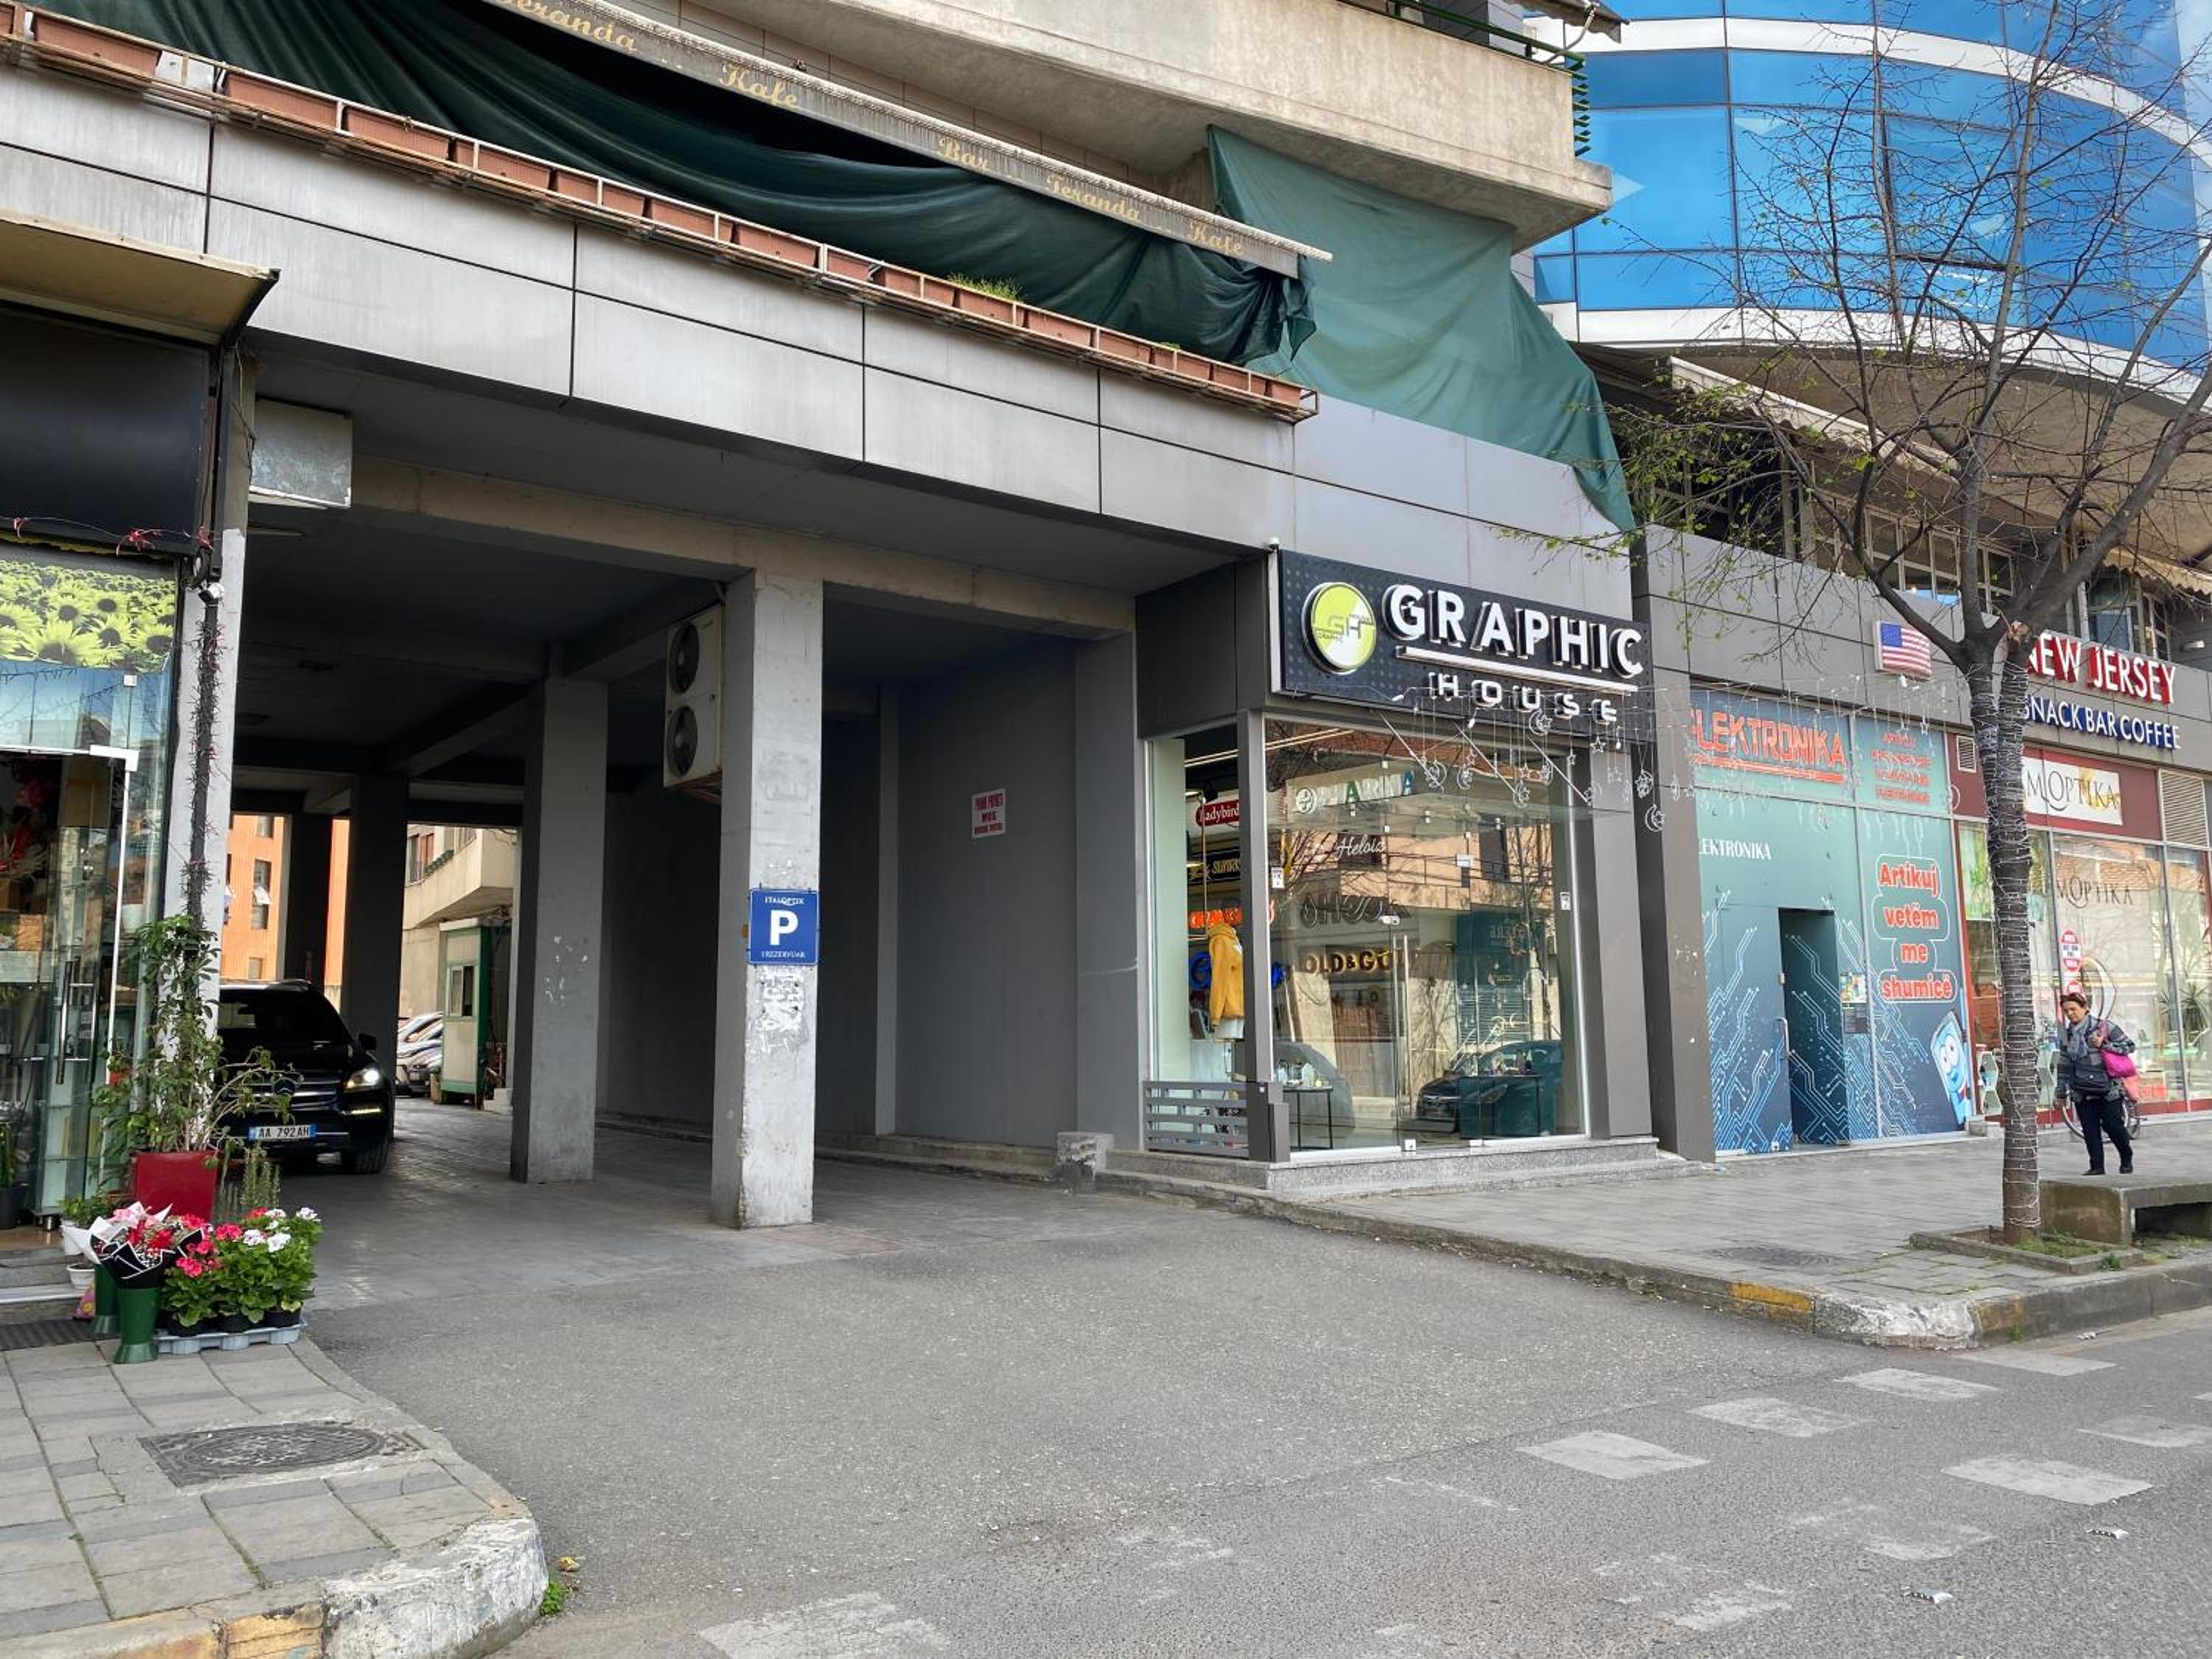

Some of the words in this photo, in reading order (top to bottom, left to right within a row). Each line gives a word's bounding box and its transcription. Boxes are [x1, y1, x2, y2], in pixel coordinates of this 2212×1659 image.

[717, 62, 799, 109] Kafe
[938, 137, 992, 171] Bar
[1046, 173, 1142, 223] Teranda
[1187, 219, 1245, 256] Kafe
[1383, 584, 1644, 678] GRAPHIC
[2093, 646, 2176, 703] JERSEY
[1429, 672, 1618, 725] HOUSE
[2085, 706, 2118, 737] BAR
[2120, 715, 2182, 750] COFFEE
[1879, 862, 1939, 897] Artikuj
[770, 909, 799, 946] P
[1883, 902, 1940, 929] vetëm
[1900, 943, 1928, 963] me
[1882, 973, 1953, 1000] shumicë
[260, 1128, 271, 1138] AA
[276, 1127, 296, 1138] 792
